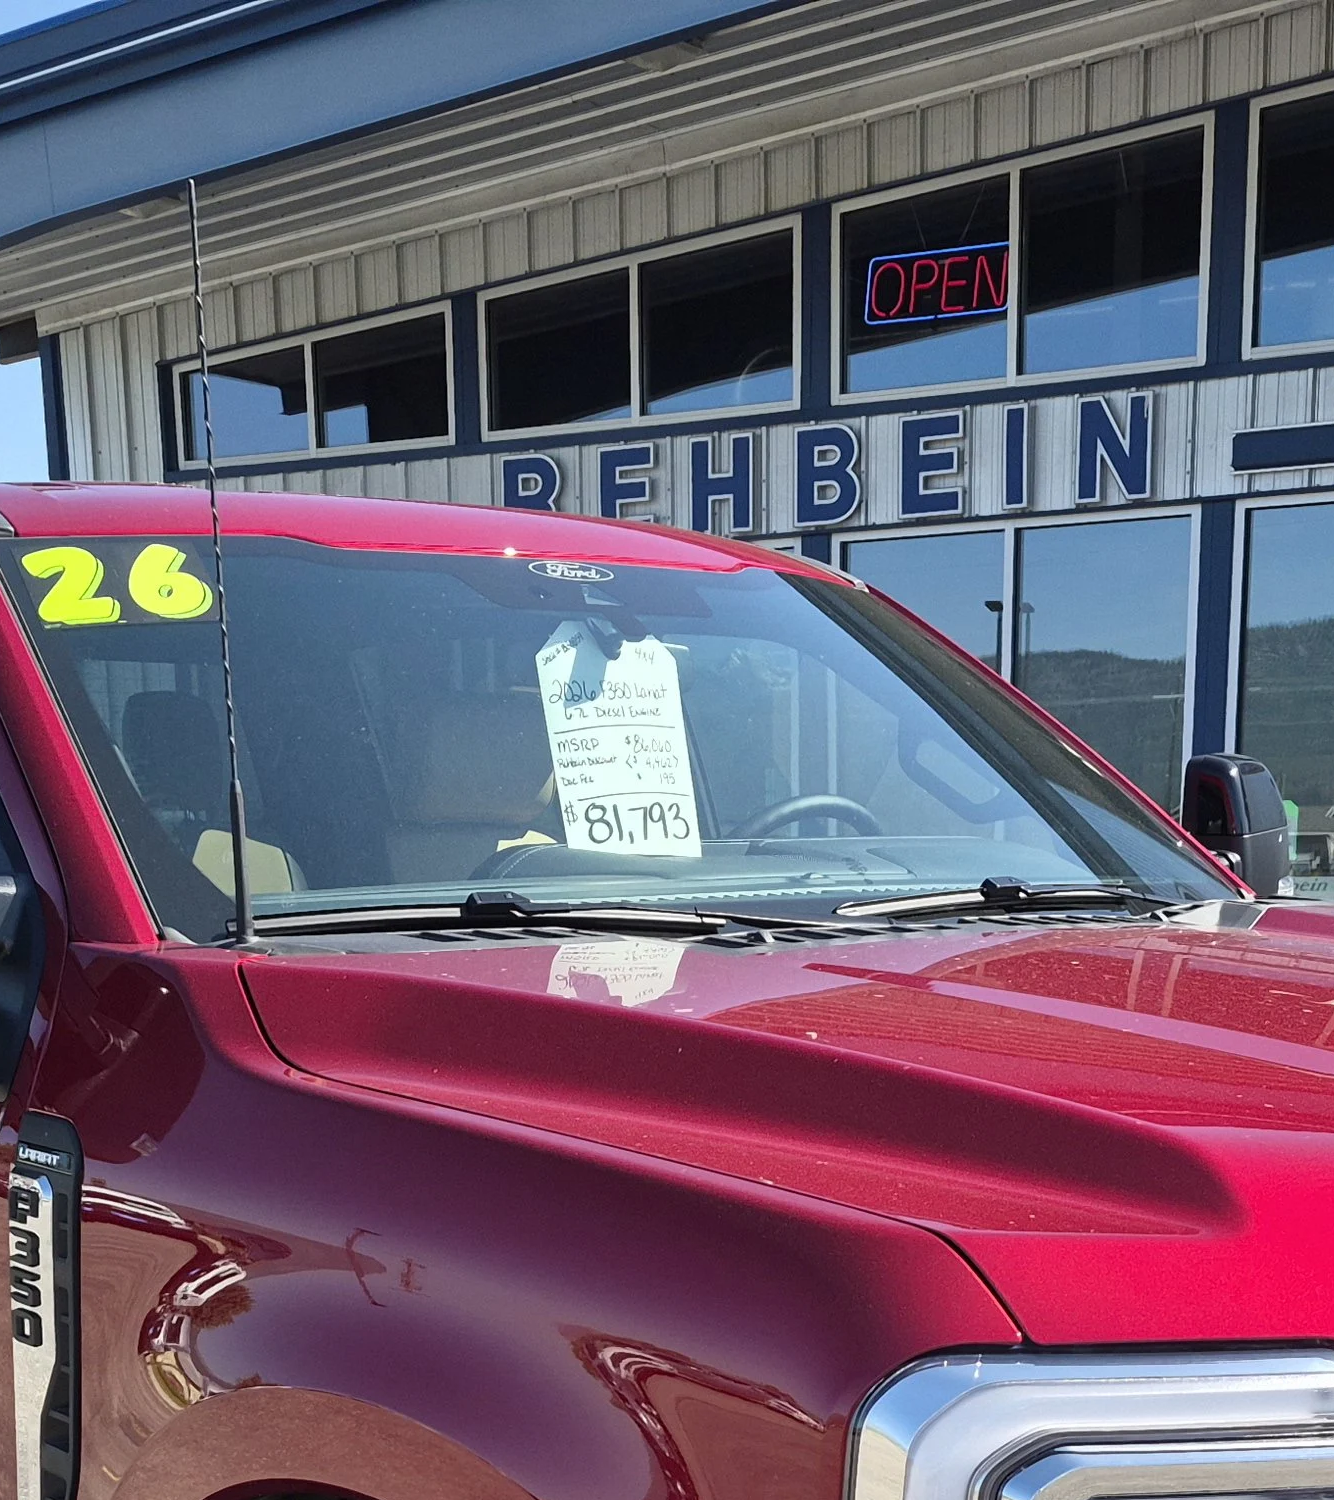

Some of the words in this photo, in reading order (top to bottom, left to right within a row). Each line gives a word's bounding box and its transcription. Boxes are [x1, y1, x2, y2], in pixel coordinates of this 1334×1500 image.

[871, 250, 1009, 317] OPEN
[500, 390, 1156, 533] REHBEIN
[21, 543, 213, 625] 26
[546, 563, 601, 579] Ford
[549, 679, 596, 704] 2026
